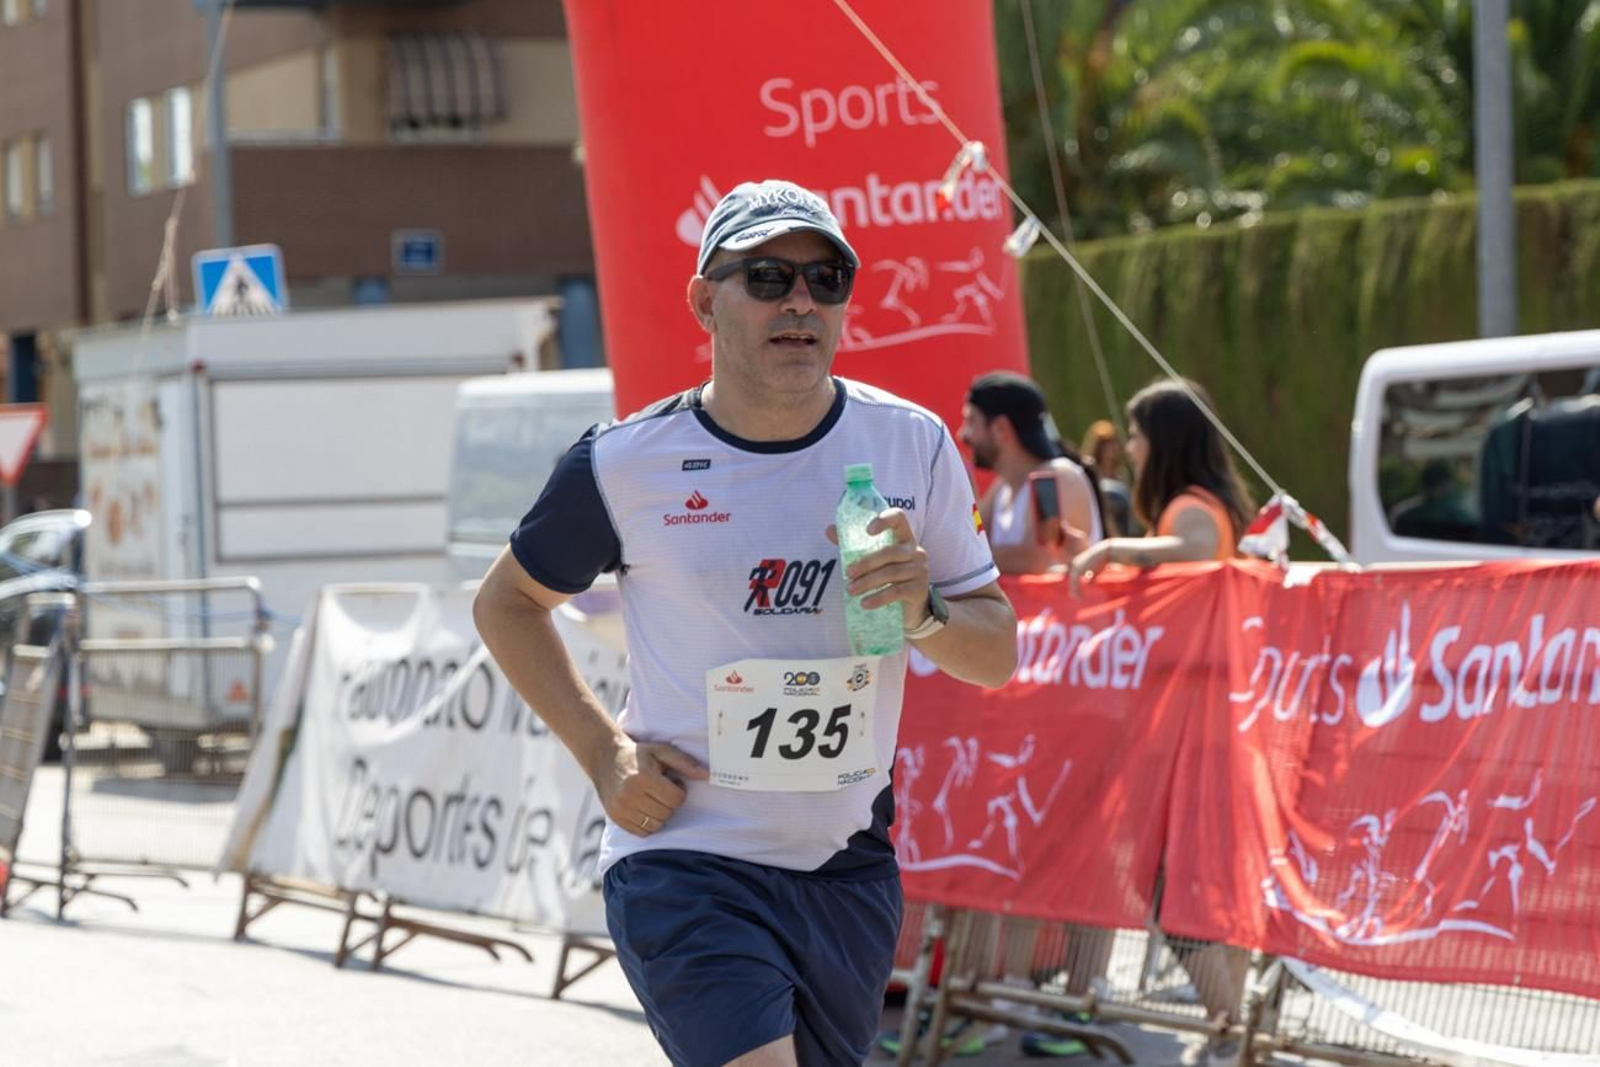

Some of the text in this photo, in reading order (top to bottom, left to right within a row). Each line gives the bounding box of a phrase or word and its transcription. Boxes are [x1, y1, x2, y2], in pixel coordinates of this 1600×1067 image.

[759, 75, 941, 148] Sports
[814, 171, 1003, 229] ntander
[663, 512, 731, 526] Santander
[713, 684, 754, 693] Santander
[747, 703, 852, 760] 135
